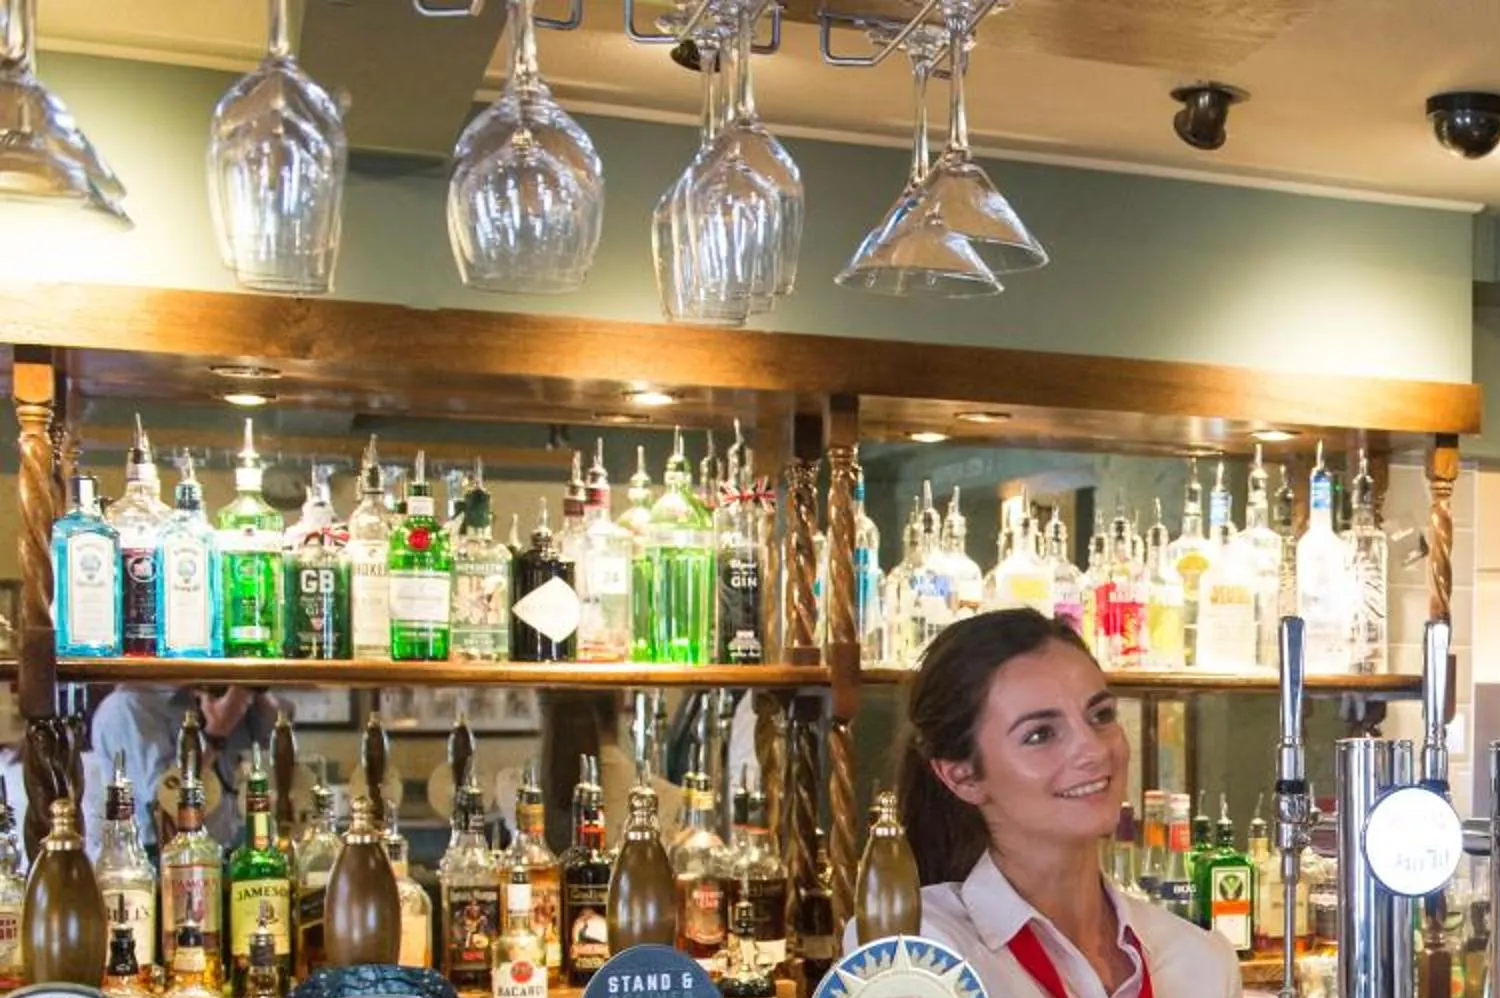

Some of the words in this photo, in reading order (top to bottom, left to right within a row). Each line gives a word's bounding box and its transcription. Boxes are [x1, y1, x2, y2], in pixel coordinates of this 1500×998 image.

[300, 569, 335, 594] GB
[730, 577, 758, 588] GIN
[608, 973, 671, 993] STAND
[681, 972, 693, 989] &
